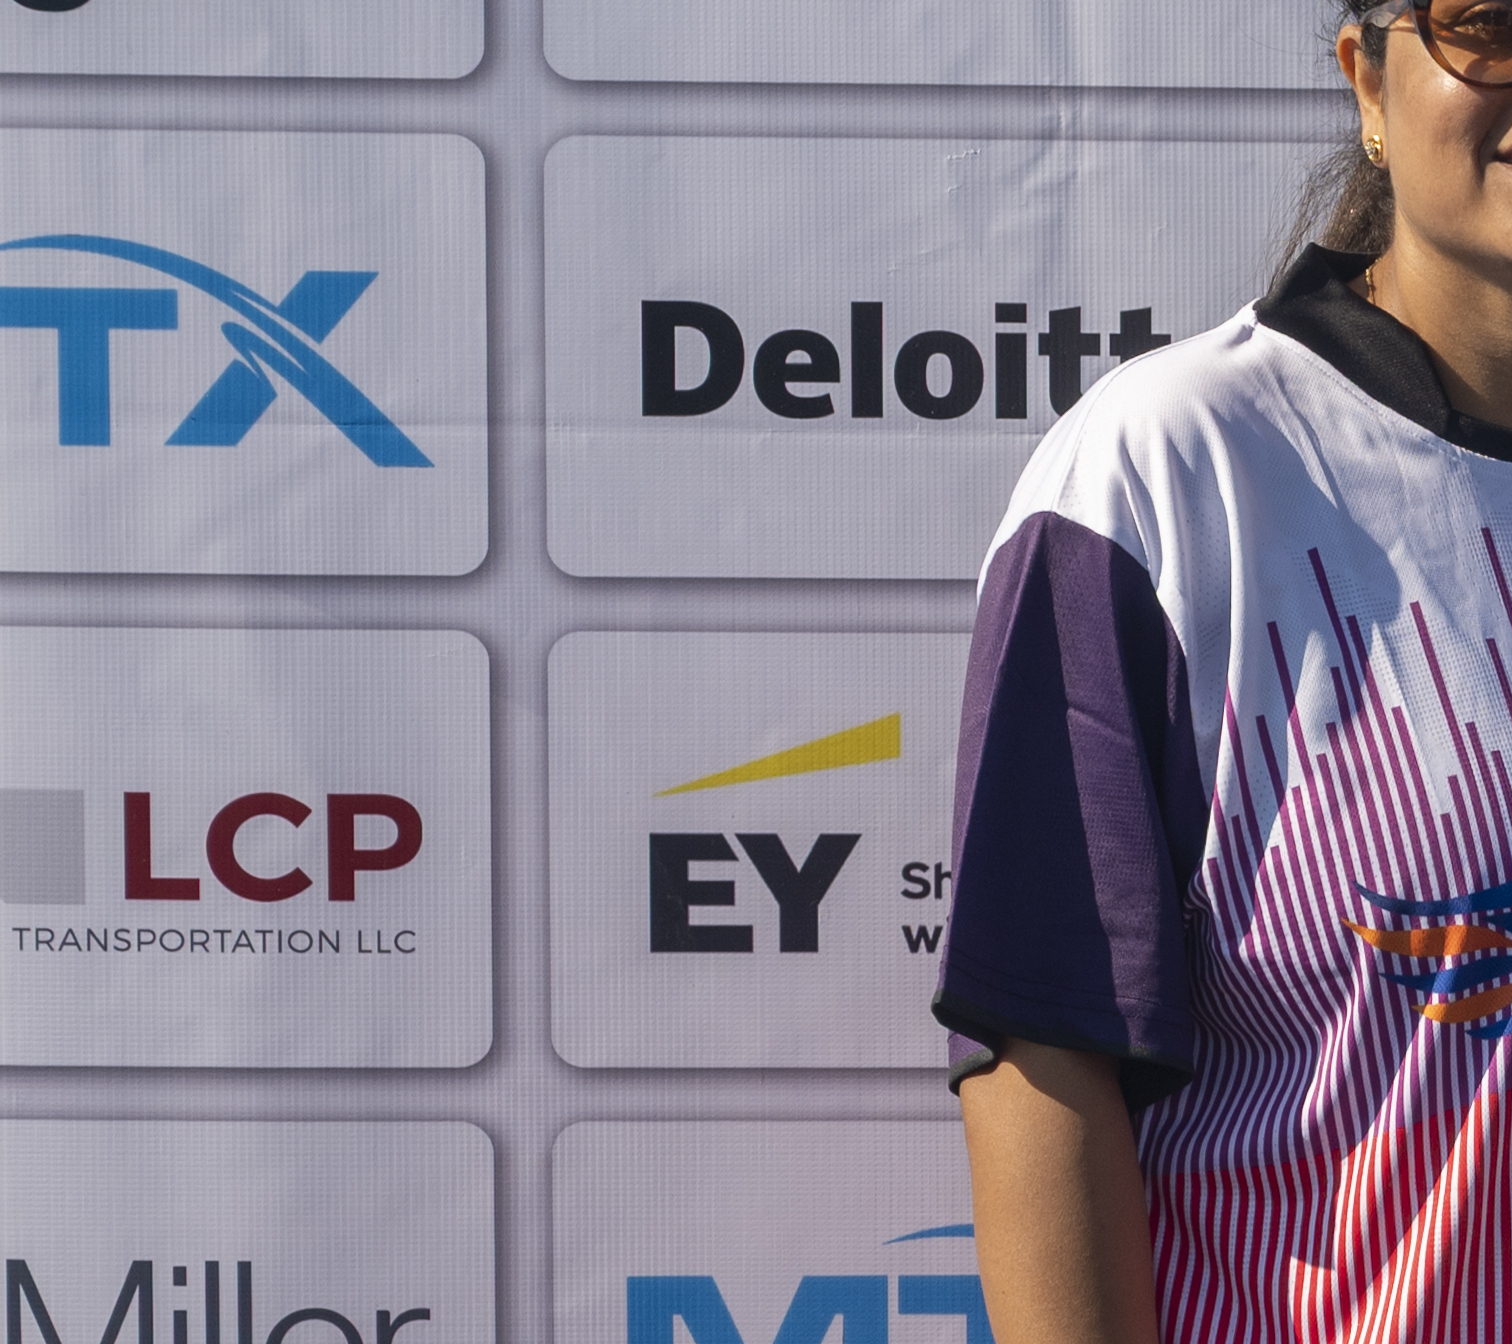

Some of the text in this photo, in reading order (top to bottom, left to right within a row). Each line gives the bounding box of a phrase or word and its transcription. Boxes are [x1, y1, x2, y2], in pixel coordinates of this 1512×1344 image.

[124, 792, 422, 902] LCP
[650, 834, 861, 953] EY
[12, 927, 417, 954] TRANSPORTATION LLC
